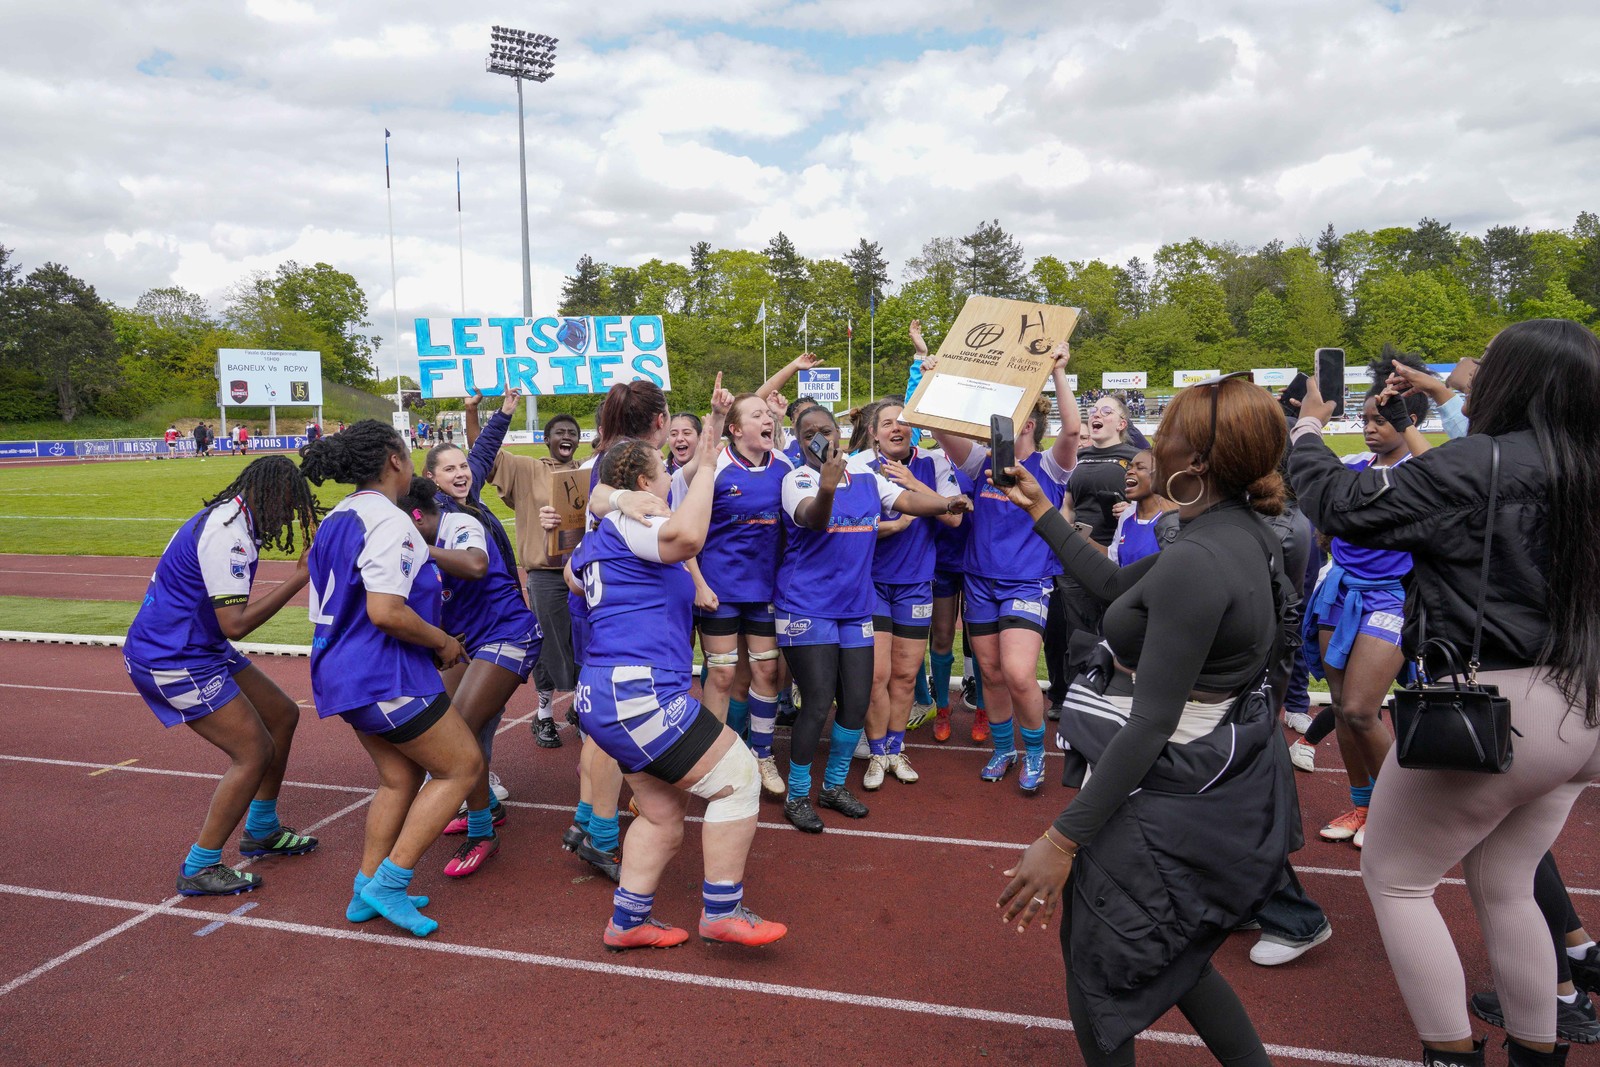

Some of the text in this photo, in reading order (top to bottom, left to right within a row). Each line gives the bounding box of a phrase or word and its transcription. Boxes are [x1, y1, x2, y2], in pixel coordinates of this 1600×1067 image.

[415, 315, 663, 356] LET'S GO
[942, 353, 1000, 367] HAUTS-DE-FRANCE
[960, 350, 1002, 361] LIGUE RUGBY
[1025, 358, 1044, 367] France
[227, 364, 266, 372] BAGNEUX
[283, 365, 309, 373] RCPXV
[1006, 361, 1041, 374] Rugby
[418, 354, 664, 399] FURIES
[123, 441, 158, 453] MASSY
[226, 438, 282, 449] CMPIONS
[202, 679, 221, 693] STADE
[666, 695, 685, 715] STADE
